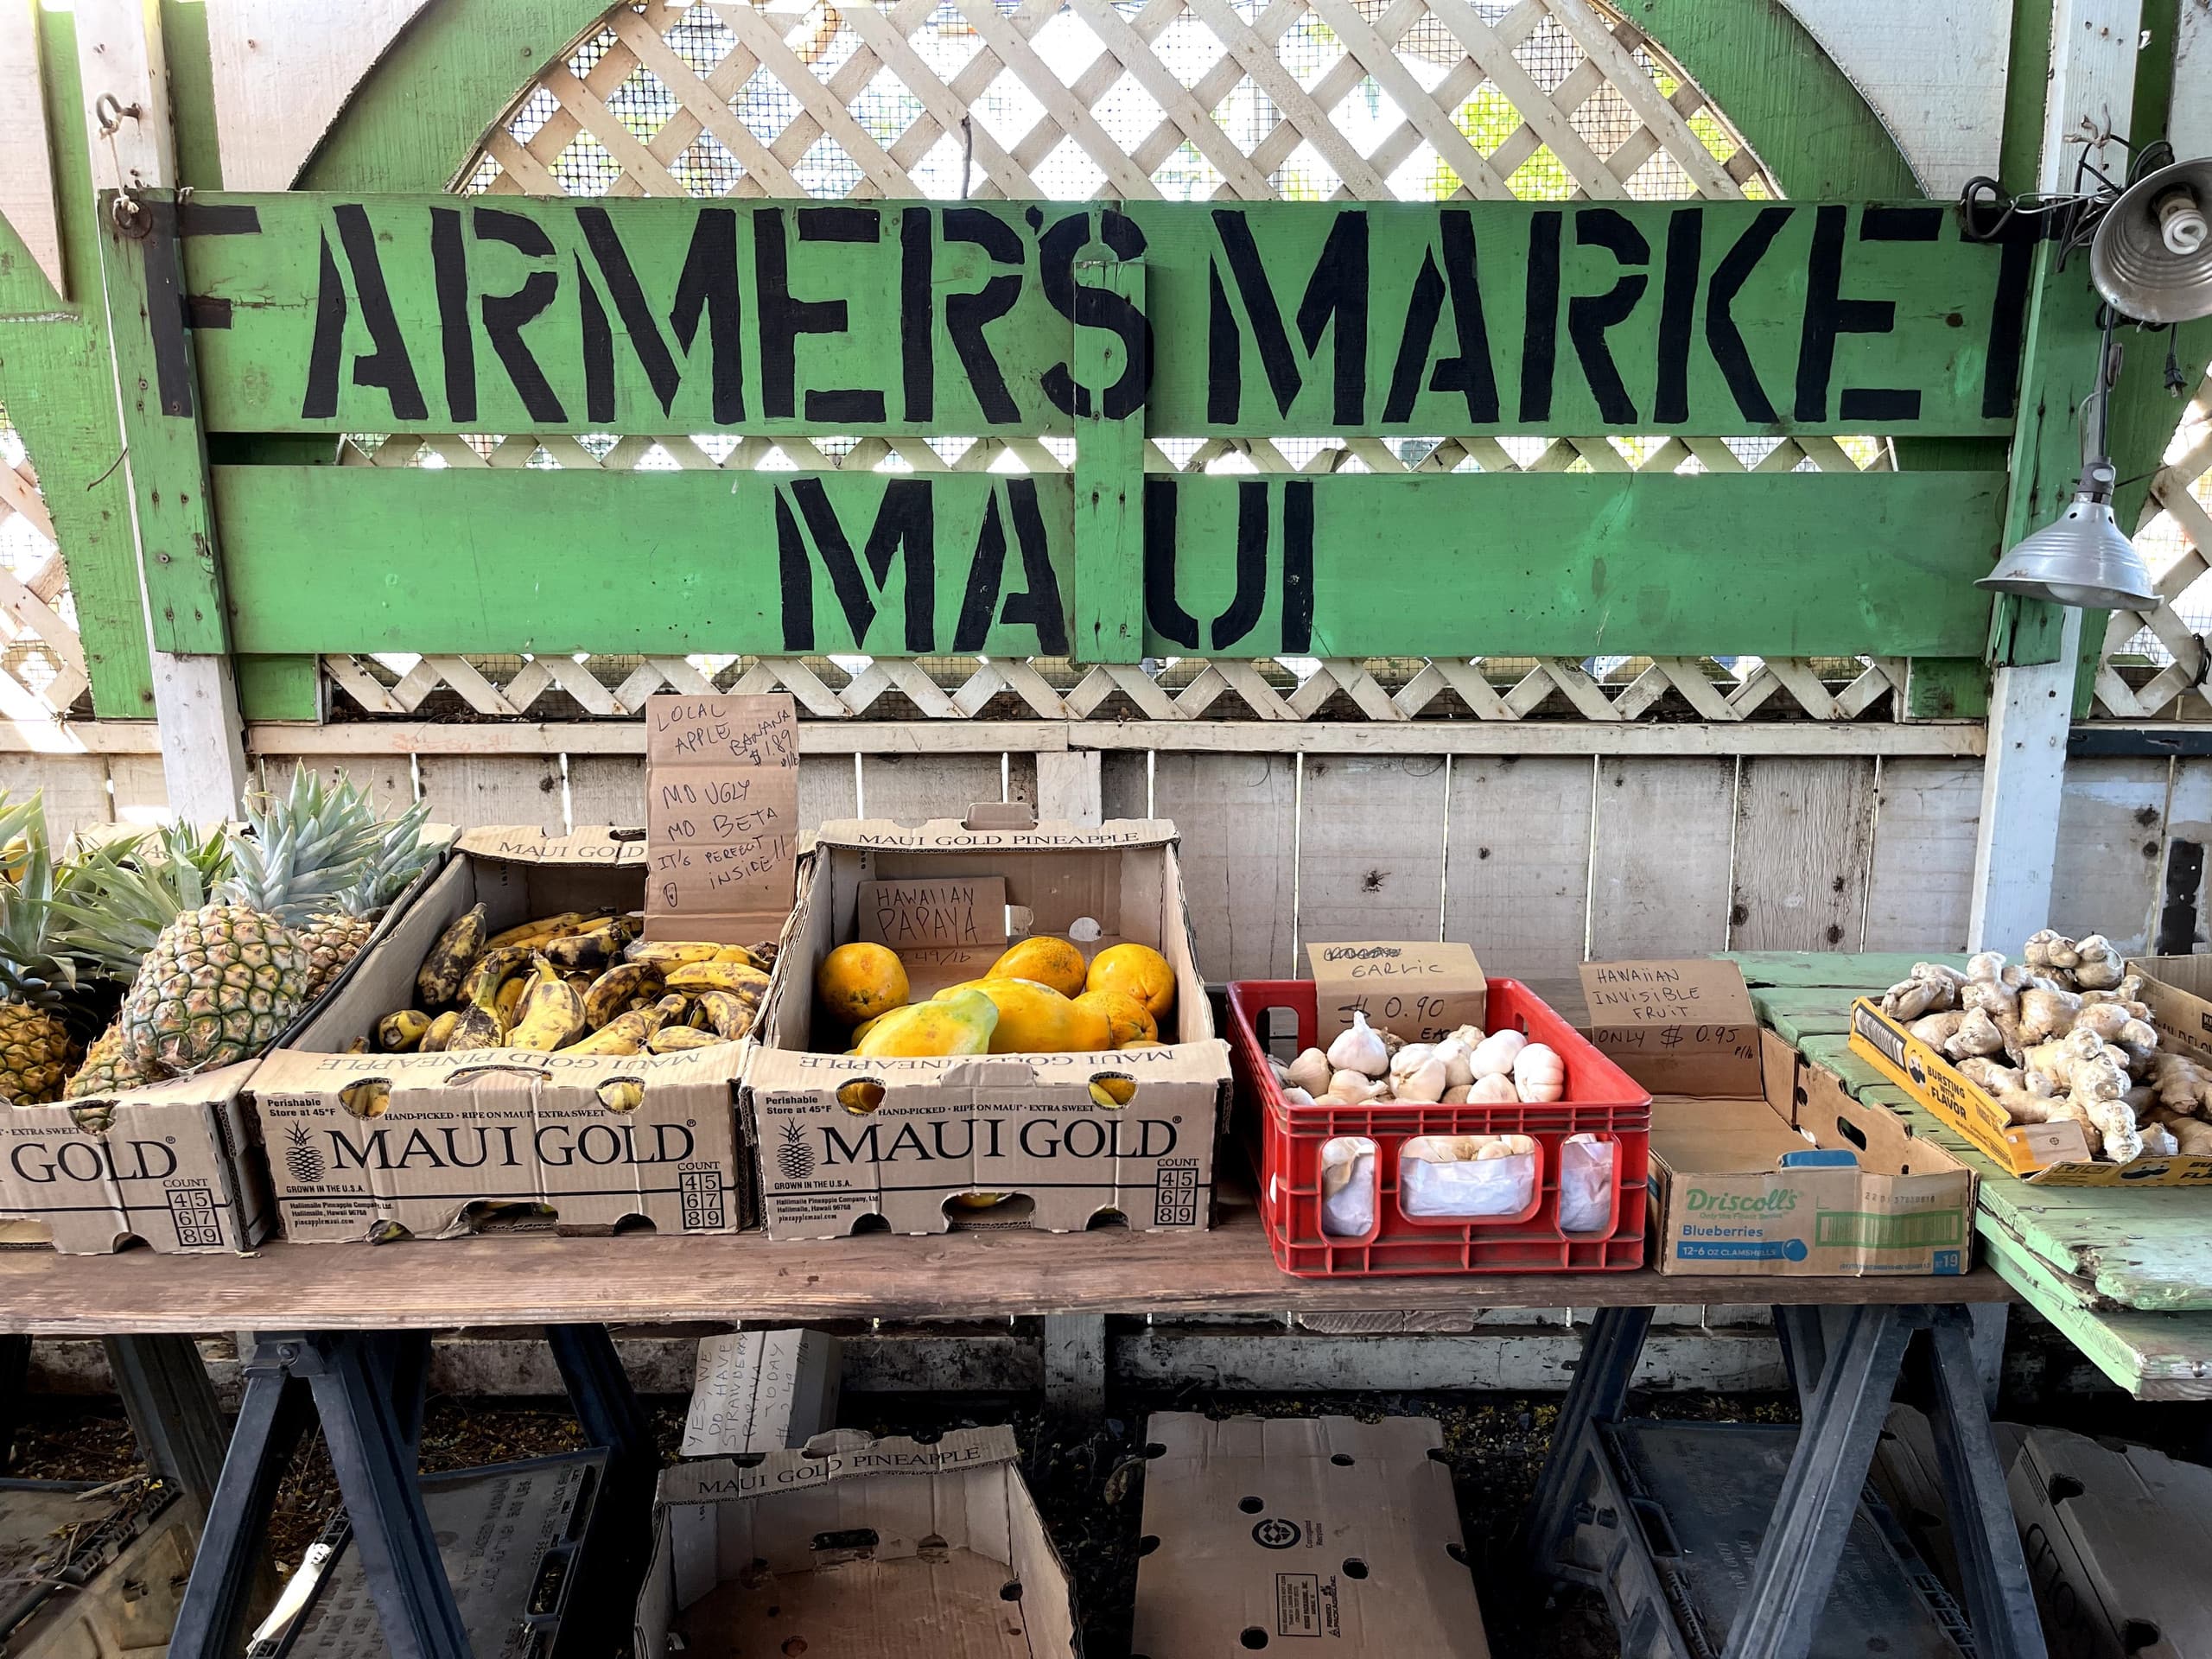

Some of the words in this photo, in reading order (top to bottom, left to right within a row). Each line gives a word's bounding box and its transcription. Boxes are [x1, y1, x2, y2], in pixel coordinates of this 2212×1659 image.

[1209, 206, 2063, 427] MARKET
[776, 475, 1314, 657] MAUI
[657, 703, 726, 732] LOCAL
[675, 721, 731, 754] APPLE
[729, 709, 791, 757] BANANA
[749, 750, 761, 766] $
[766, 728, 794, 757] 1.89
[663, 783, 696, 809] MO
[704, 779, 751, 805] UGLY
[667, 818, 696, 842] MO
[712, 807, 779, 837] BETA
[857, 833, 925, 846] MAUI
[935, 834, 1003, 846] GOLD
[1011, 831, 1140, 845] PINEAPPLE
[499, 841, 569, 858] MAUI
[705, 835, 765, 863] PERFECT
[876, 905, 979, 947] PAPAYA
[1338, 995, 1372, 1024] $
[1384, 995, 1446, 1023] 0.90
[1420, 1027, 1453, 1041] EAC
[1598, 1029, 1646, 1049] ONLY
[1659, 1024, 1685, 1050] $
[1695, 1024, 1740, 1044] 0.95
[319, 1053, 494, 1071] PINEAPPLE
[508, 1052, 601, 1069] GOLD
[612, 1052, 700, 1071] MAUI
[1087, 1049, 1175, 1066] MAUI
[1926, 1065, 1966, 1099] BURSTING
[267, 1097, 321, 1108] Perishable
[766, 1096, 818, 1105] Perishable
[1930, 1085, 1967, 1121] FLAVOR
[270, 1108, 297, 1117] Store
[299, 1108, 311, 1117] at
[385, 1111, 454, 1122] HAND-PICKED
[461, 1110, 486, 1120] RIPE
[486, 1110, 502, 1119] ON
[538, 1109, 571, 1119] EXTRA
[571, 1109, 607, 1118] SWEET
[878, 1107, 946, 1116] HAND-PICKED
[953, 1104, 976, 1113] RIPE
[977, 1103, 994, 1112] ON
[1061, 1104, 1095, 1113] SWEET
[11, 1128, 46, 1137] EXTRA
[46, 1127, 81, 1135] SWEET
[323, 1126, 523, 1170] MAUI
[817, 1118, 1007, 1166] MAUI
[677, 1161, 721, 1171] COUNT
[1156, 1158, 1200, 1167] COUNT
[162, 1178, 209, 1189] COUNT
[684, 1175, 698, 1191] 4
[704, 1174, 717, 1190] 5
[1161, 1172, 1175, 1186] 4
[1180, 1172, 1193, 1186] 5
[173, 1192, 188, 1208] 4
[194, 1192, 208, 1208] 5
[686, 1193, 699, 1209] 6
[706, 1192, 717, 1208] 7
[808, 1197, 838, 1205] Pineapple
[838, 1196, 868, 1205] Company,
[1160, 1190, 1173, 1205] 6
[1179, 1189, 1192, 1205] 7
[1686, 1188, 1798, 1211] Driscoll's
[178, 1210, 193, 1225] 6
[197, 1210, 211, 1225] 7
[294, 1217, 355, 1228] pineapplemaui.com
[688, 1211, 701, 1227] 8
[707, 1211, 719, 1226] 9
[779, 1212, 837, 1224] pineapplemaui.com
[1160, 1207, 1173, 1223] 8
[1179, 1207, 1192, 1223] 9
[182, 1228, 198, 1244] 8
[202, 1227, 217, 1243] 9
[1682, 1224, 1764, 1237] Blueberries
[1683, 1246, 1705, 1256] 12-6
[1707, 1248, 1719, 1256] OZ
[1942, 1254, 1959, 1268] 19
[696, 1351, 712, 1382] WE
[713, 1343, 732, 1397] HAVE
[764, 1342, 784, 1418] TODAY
[708, 1413, 723, 1436] DO
[698, 1473, 767, 1495] MAUI
[776, 1459, 843, 1484] GOLD
[853, 1446, 981, 1468] PINEAPPLE
